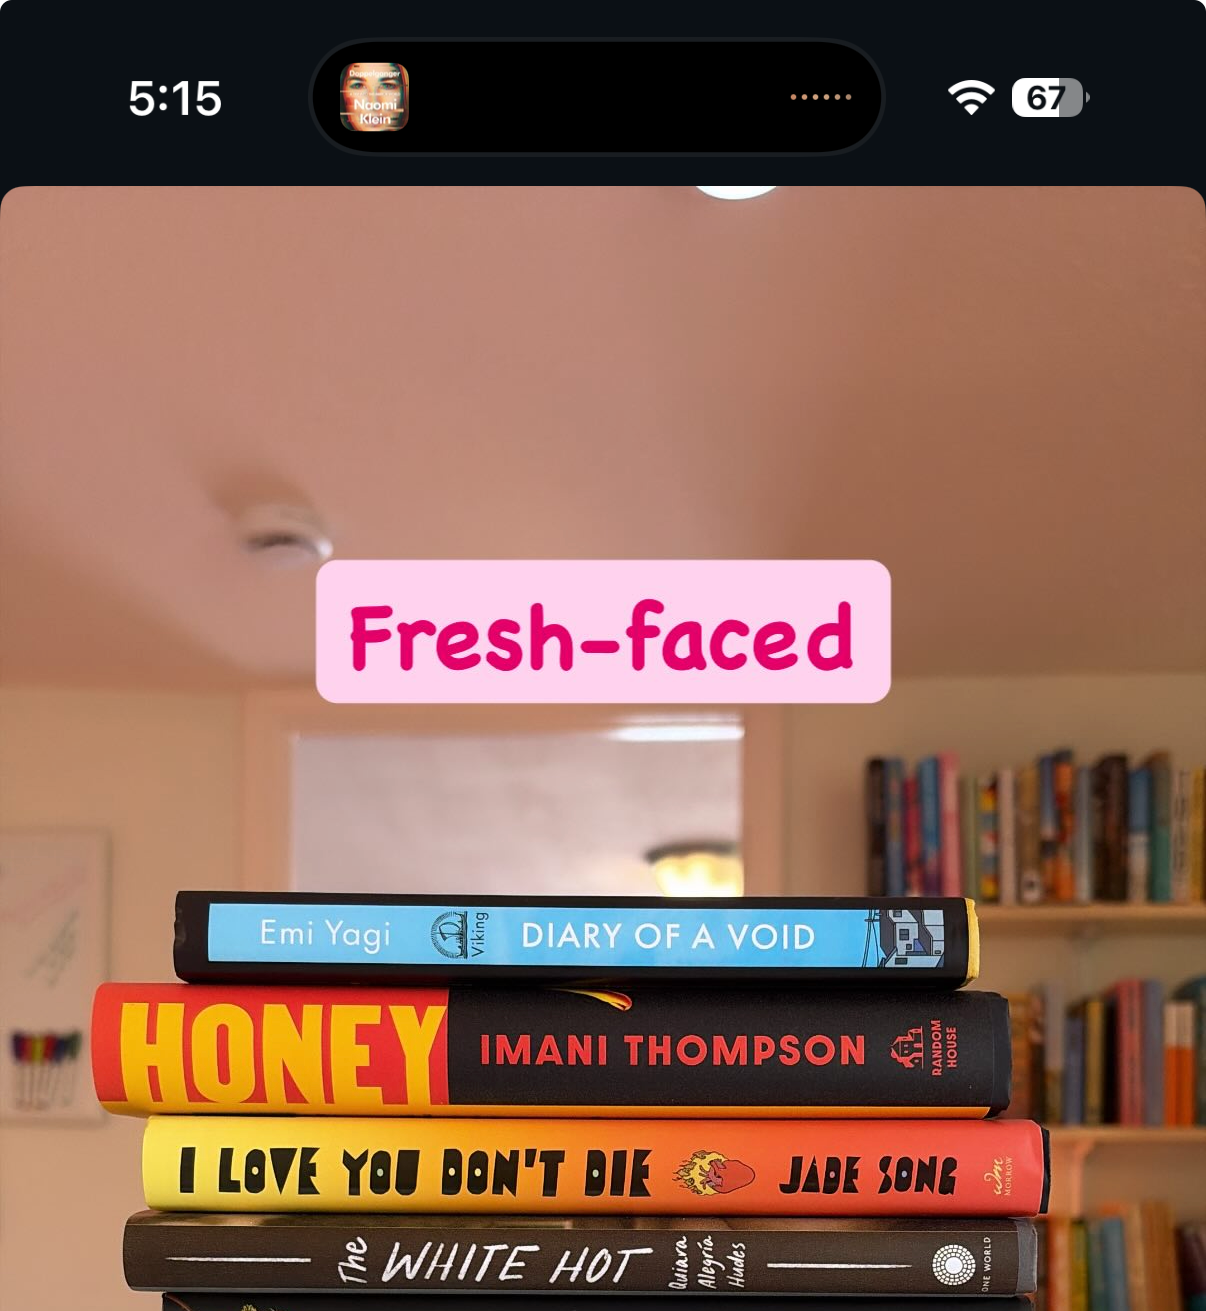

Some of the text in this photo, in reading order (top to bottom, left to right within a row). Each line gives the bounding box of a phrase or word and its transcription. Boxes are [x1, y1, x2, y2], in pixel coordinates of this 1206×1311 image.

[128, 80, 222, 117] 5:15
[353, 98, 397, 111] Naomi
[360, 113, 391, 125] Klein
[1026, 85, 1066, 111] 67
[261, 919, 391, 955] Emi Yagi
[470, 912, 489, 957] Viking
[522, 922, 816, 950] DIARY OF A VOID
[121, 1002, 448, 1105] HONEY
[480, 1034, 866, 1066] IMANI THOMPSON
[931, 1019, 943, 1077] RANDOM
[946, 1026, 959, 1069] HOUSE
[179, 1147, 654, 1198] I LOVE YOU DON'T DIE
[779, 1156, 958, 1196] JADE SONG
[1004, 1157, 1013, 1196] MORROW
[338, 1236, 369, 1284] The
[381, 1241, 654, 1285] WHITE HOT
[668, 1235, 689, 1290] Quiara
[696, 1235, 726, 1290] Alegría
[726, 1242, 746, 1288] Hudes
[981, 1236, 992, 1293] ONE WORLD
